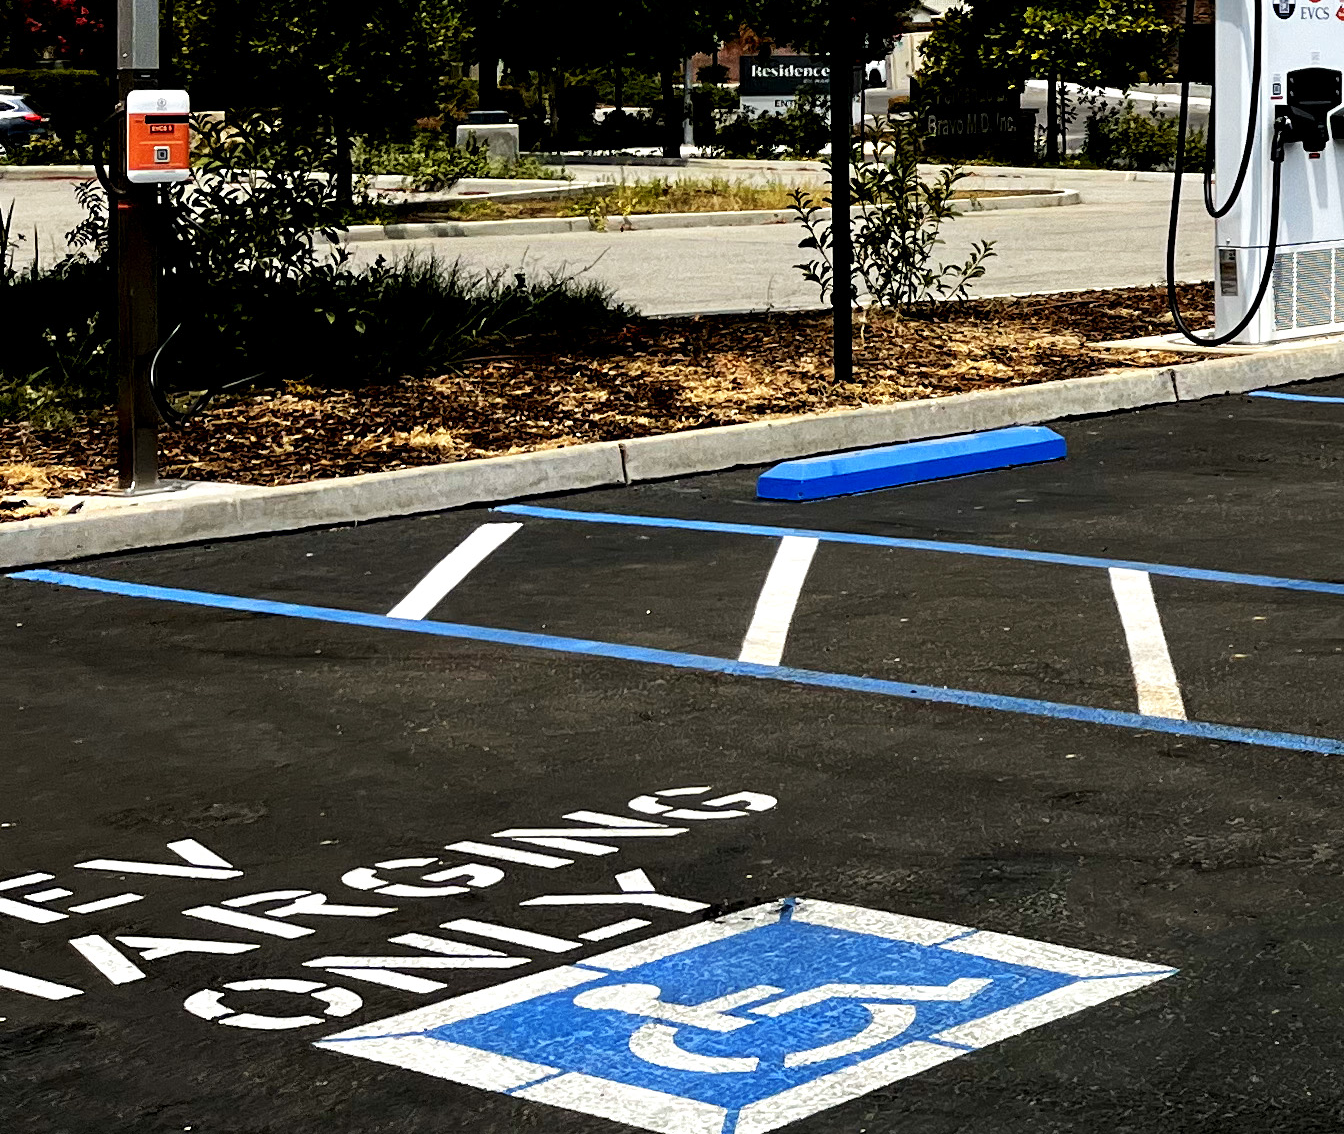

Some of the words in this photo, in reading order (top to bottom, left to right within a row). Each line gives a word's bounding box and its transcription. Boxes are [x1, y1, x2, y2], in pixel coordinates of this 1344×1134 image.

[1300, 6, 1330, 20] EVCS
[751, 64, 831, 78] Residence
[0, 838, 244, 924] EV
[183, 867, 712, 1031] ONLY
